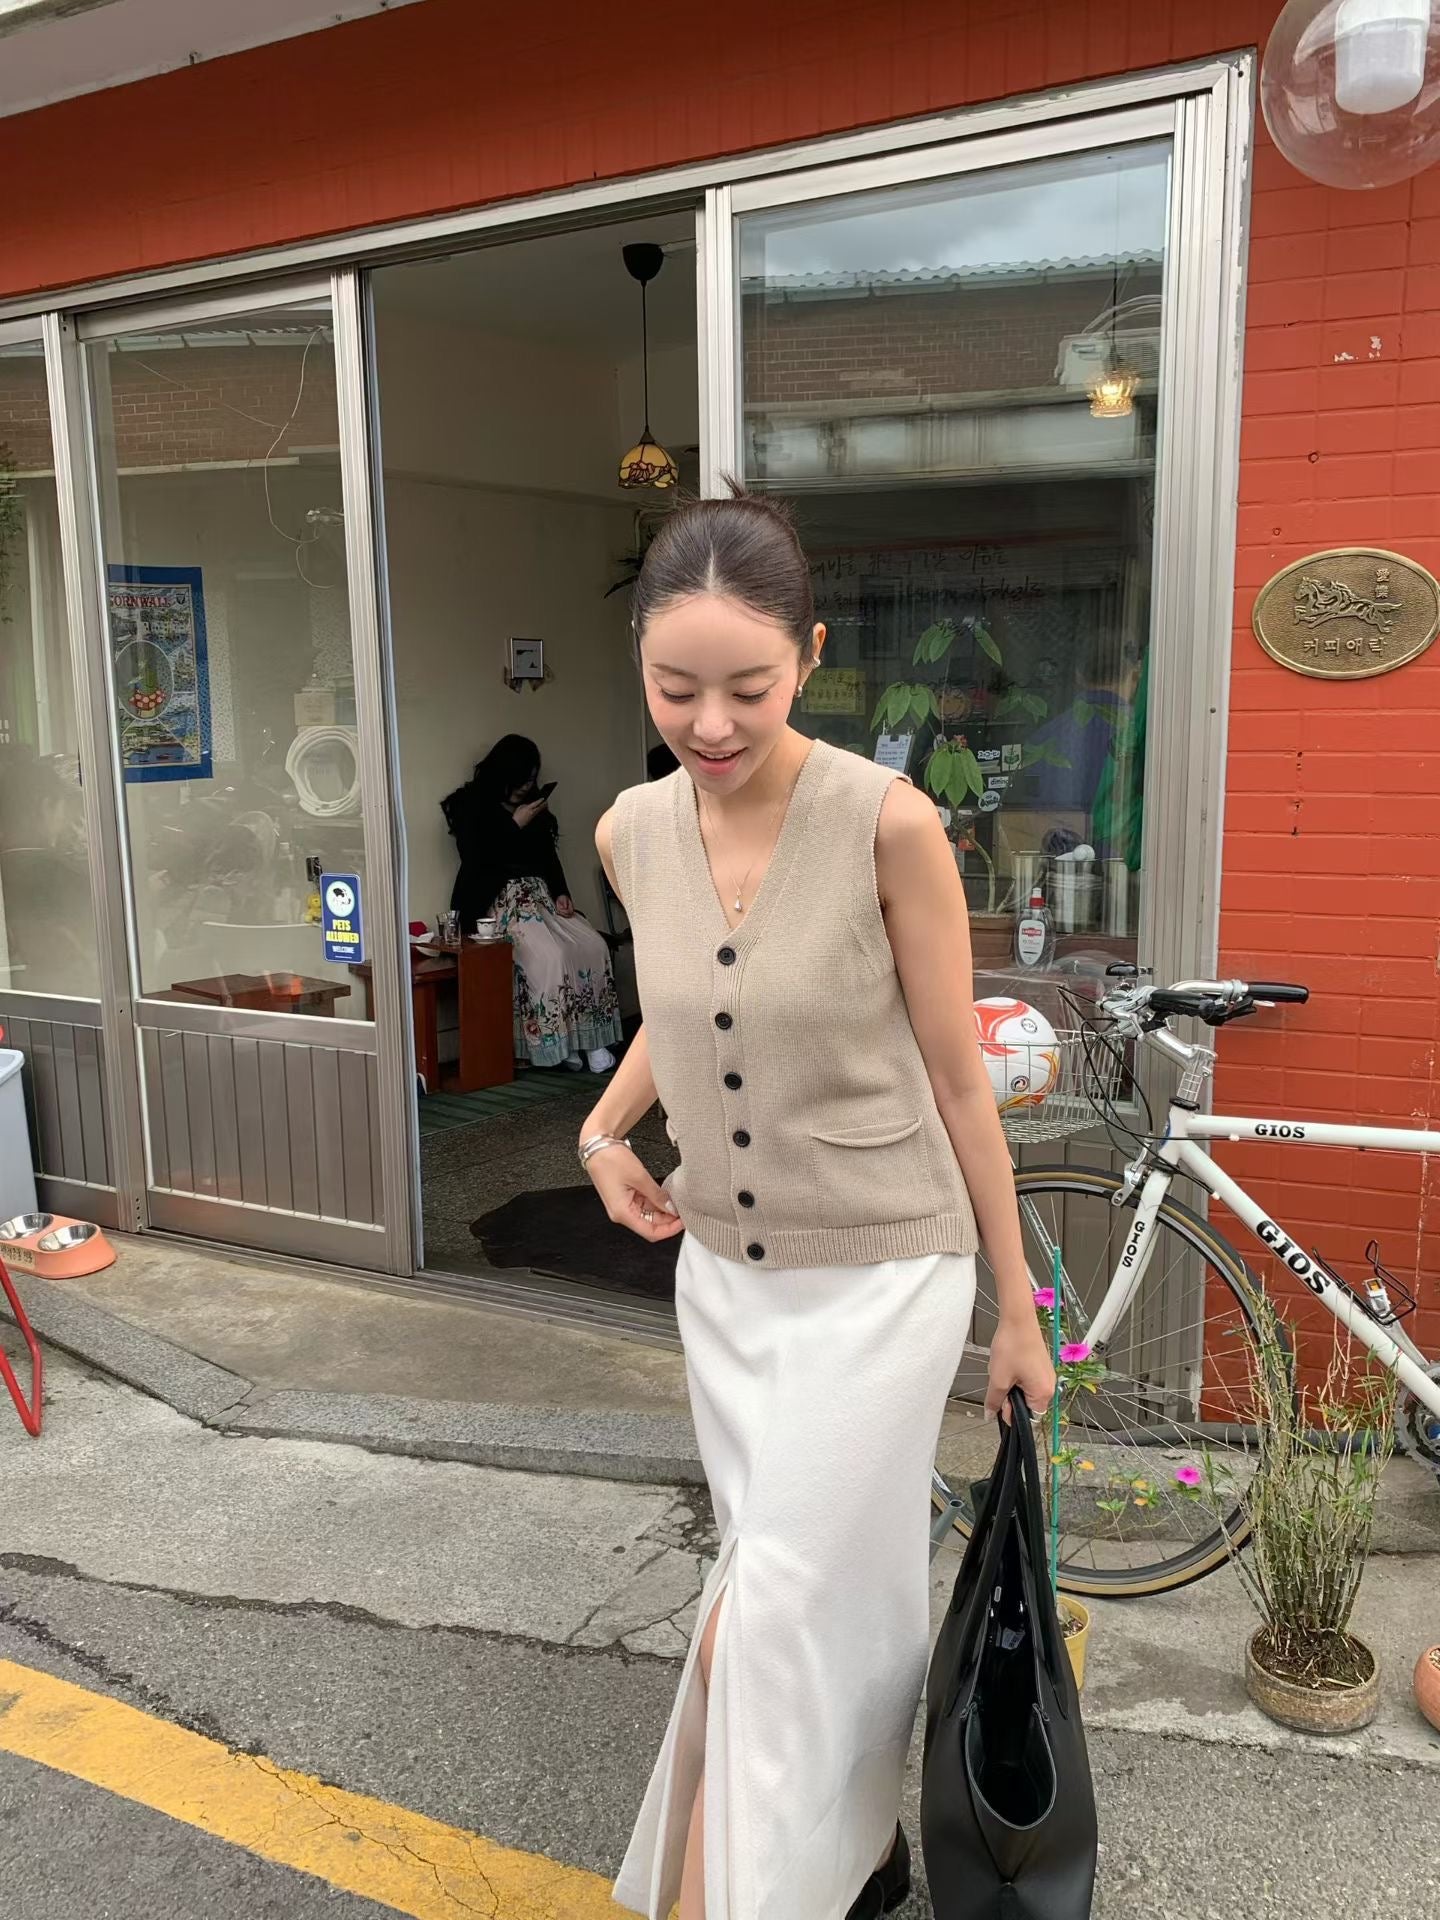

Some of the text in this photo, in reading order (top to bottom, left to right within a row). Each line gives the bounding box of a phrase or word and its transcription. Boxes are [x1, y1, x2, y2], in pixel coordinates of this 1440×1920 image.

[332, 919, 351, 931] PETS
[326, 930, 359, 943] ALLOWED
[1255, 1123, 1306, 1139] GIOS
[1121, 1220, 1146, 1268] GIOS
[1256, 1220, 1331, 1295] GIOS
